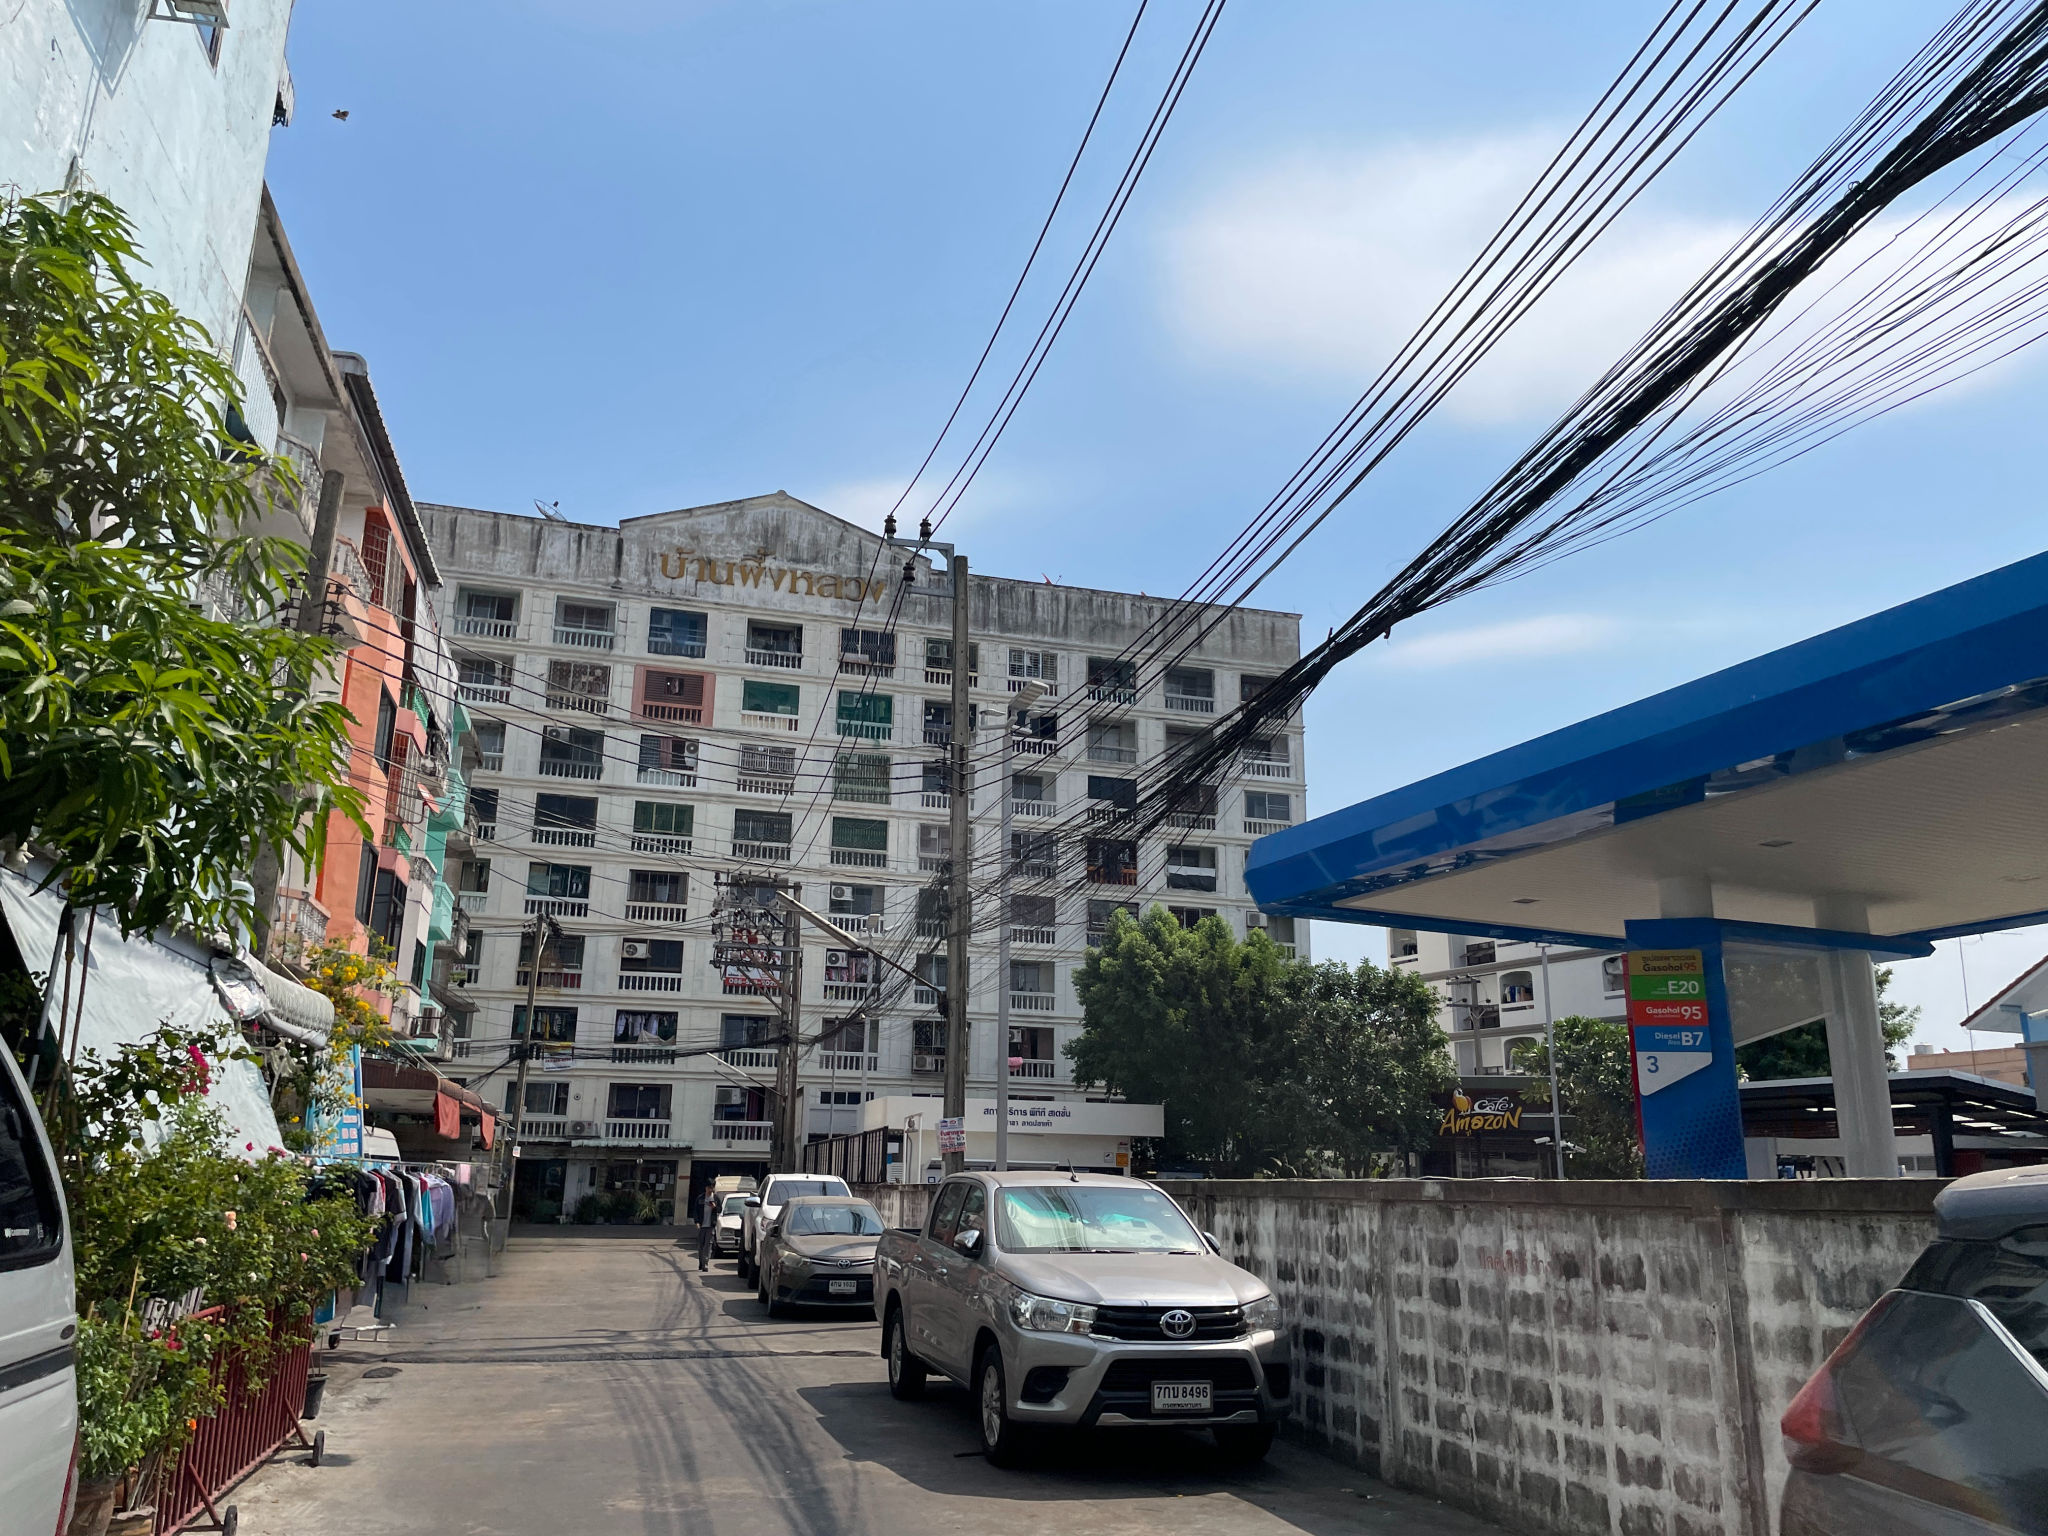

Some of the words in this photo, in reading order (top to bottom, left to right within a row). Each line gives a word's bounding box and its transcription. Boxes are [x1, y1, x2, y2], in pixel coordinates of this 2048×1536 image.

[1643, 962, 1683, 973] Gasohol
[1684, 962, 1697, 972] 95
[1668, 981, 1699, 995] E20
[1646, 1006, 1680, 1014] Gasohol
[1681, 1006, 1702, 1020] 95
[1655, 1032, 1680, 1041] Diesel
[1681, 1032, 1703, 1046] B7
[1646, 1055, 1659, 1073] 3
[1182, 1386, 1208, 1399] 8496
